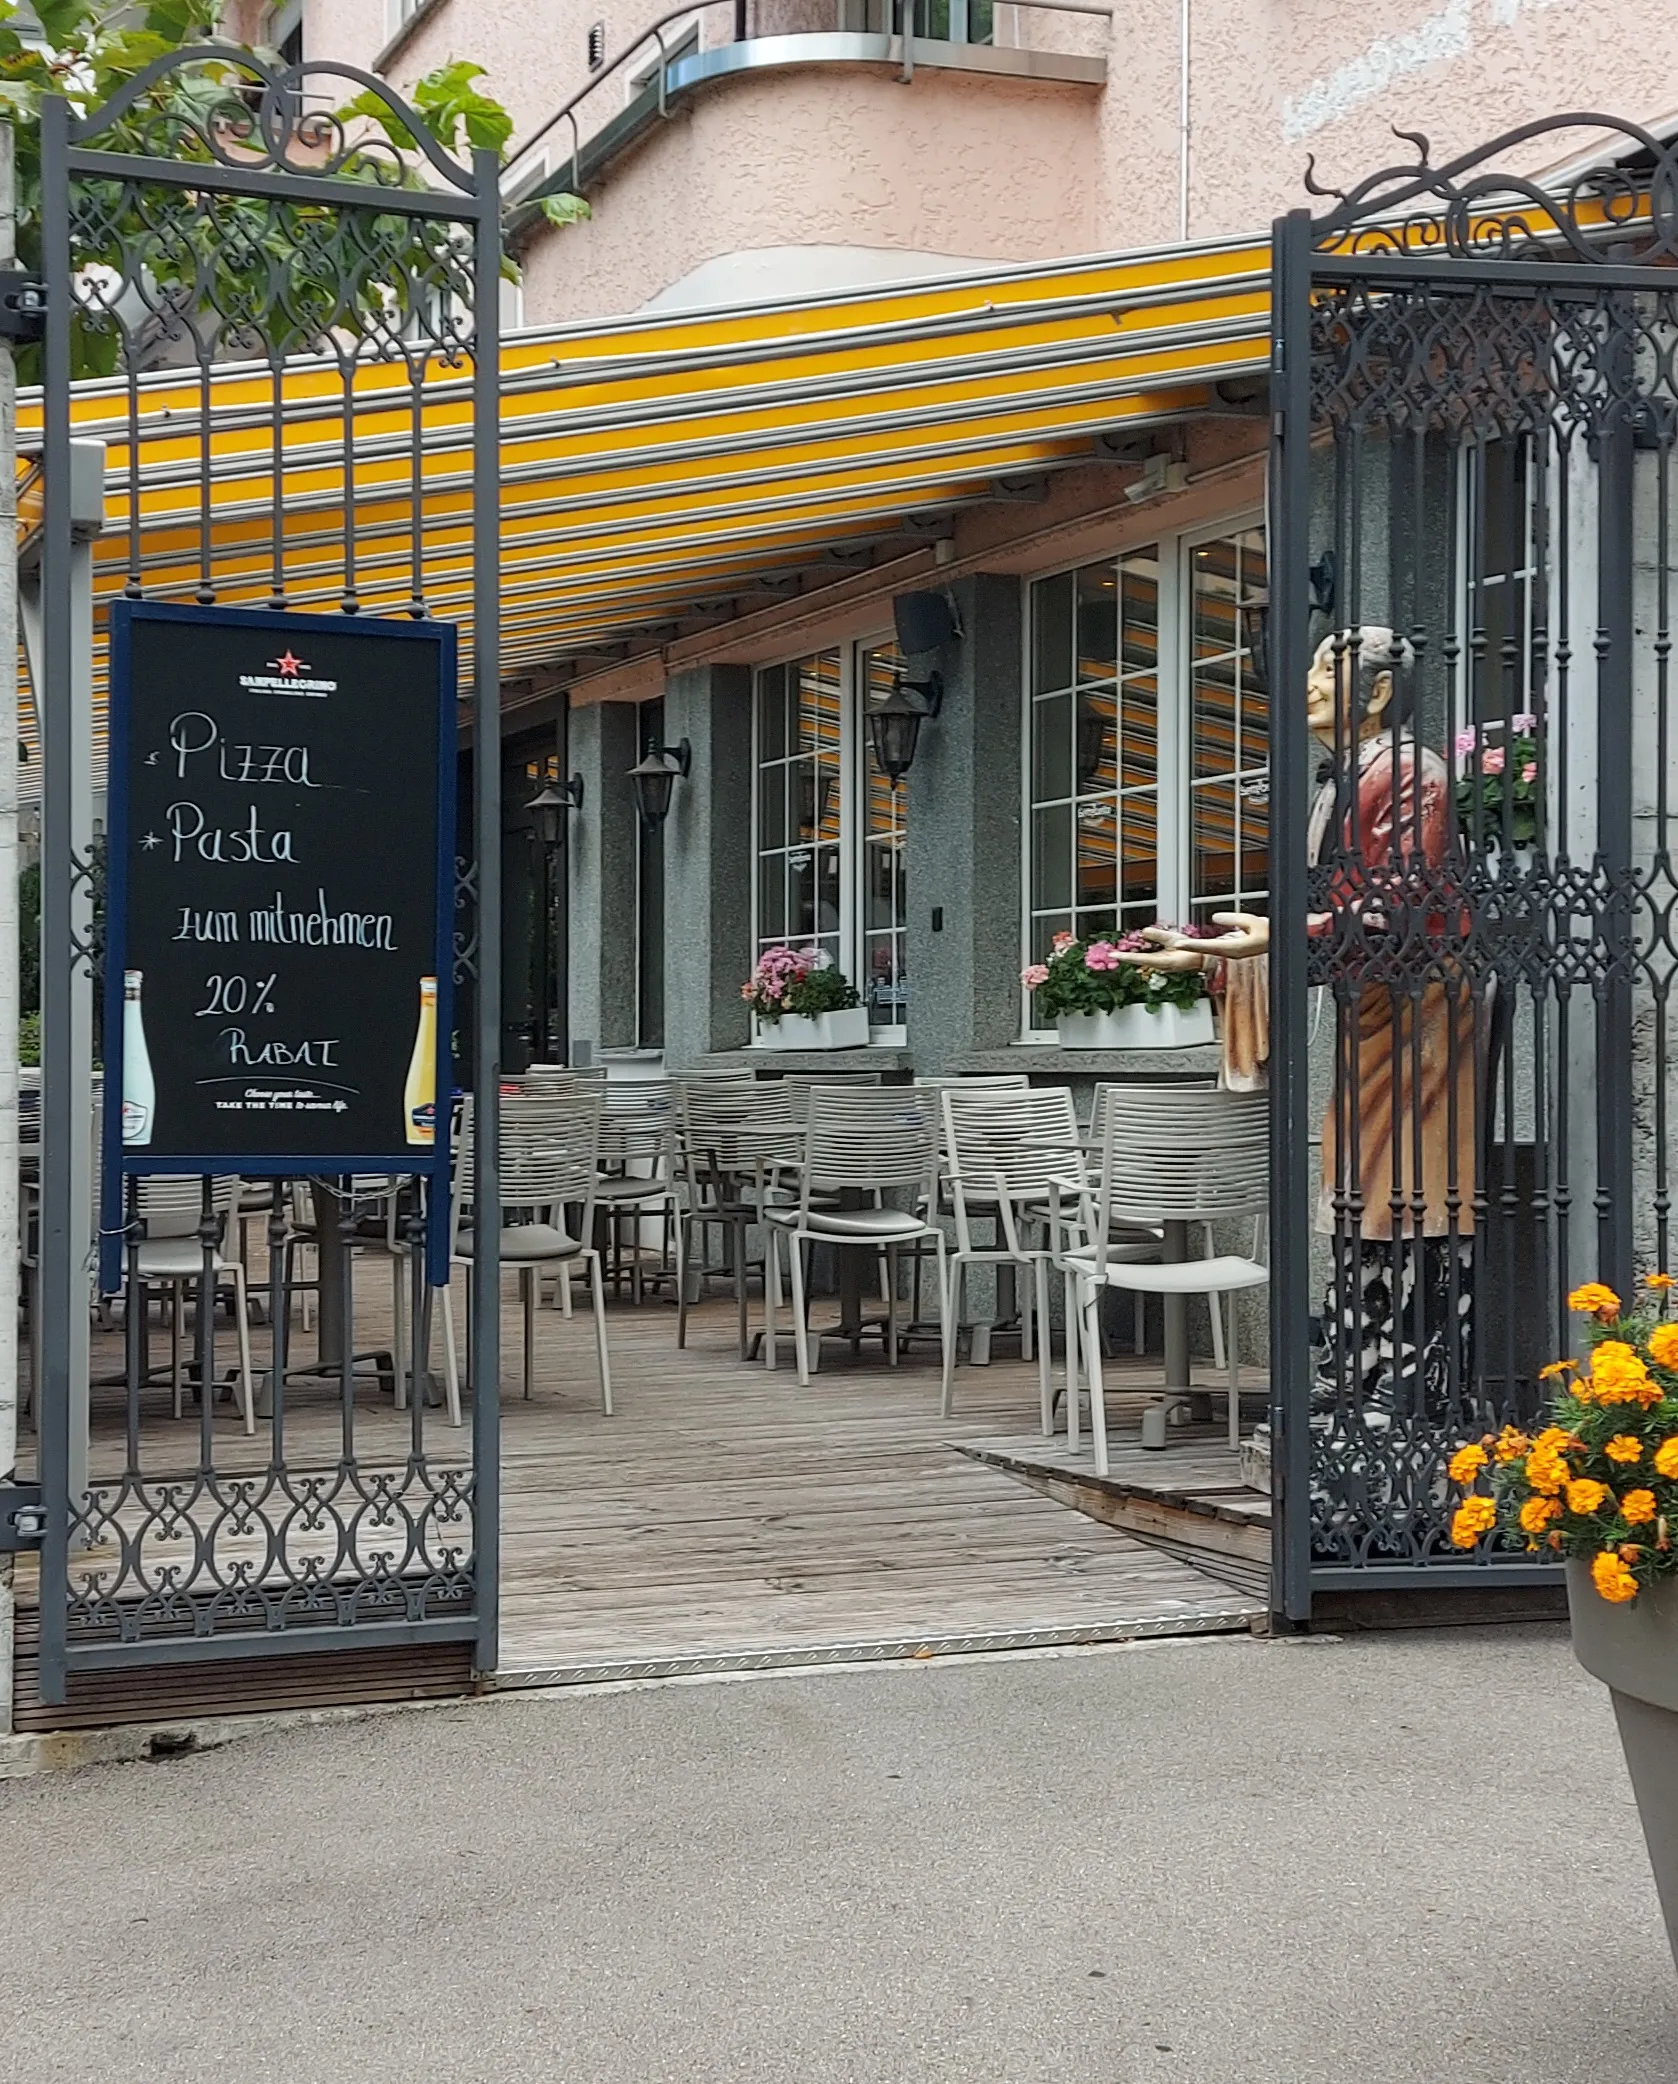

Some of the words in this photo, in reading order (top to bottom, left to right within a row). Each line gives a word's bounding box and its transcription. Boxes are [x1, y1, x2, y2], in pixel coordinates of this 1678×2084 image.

[169, 711, 322, 788] Pizza
[165, 801, 301, 864] Pasta
[171, 905, 240, 944] zum
[249, 887, 399, 952] mitnehmen
[194, 972, 278, 1018] 20%
[245, 1101, 266, 1109] THE
[268, 1101, 293, 1109] TIME
